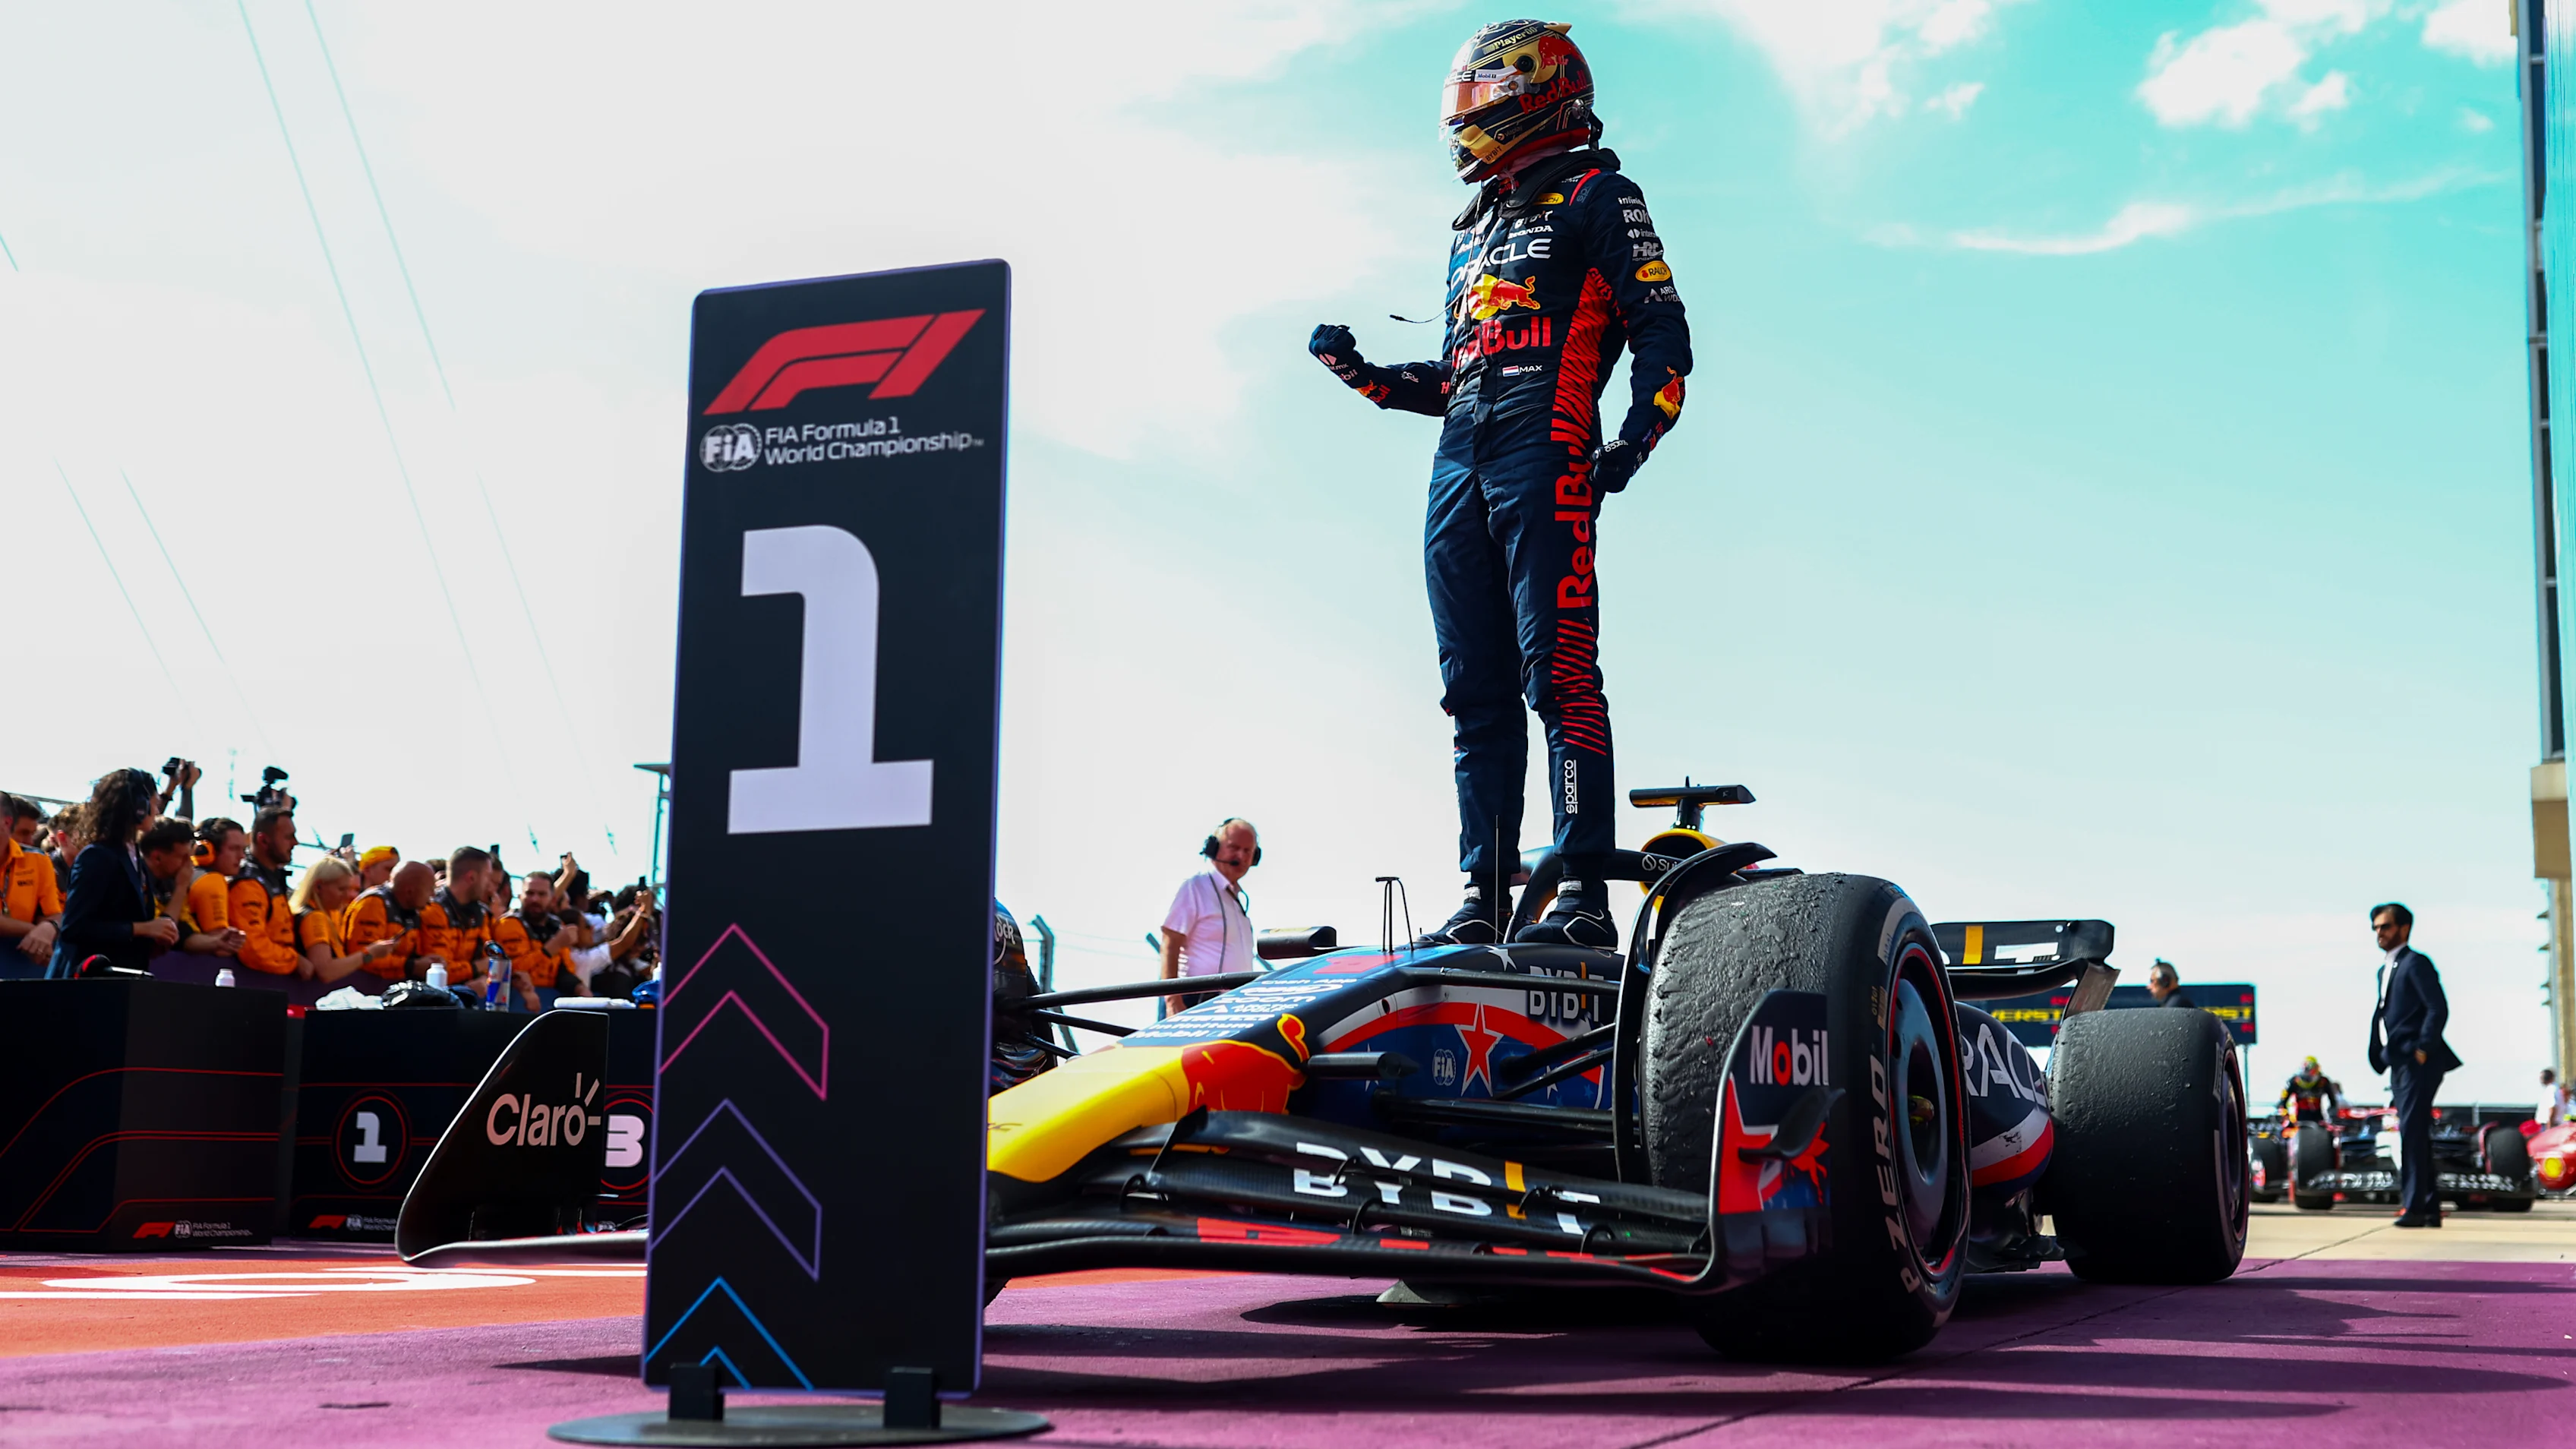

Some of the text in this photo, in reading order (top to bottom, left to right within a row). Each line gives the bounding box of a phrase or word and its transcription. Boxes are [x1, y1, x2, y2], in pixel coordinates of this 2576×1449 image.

[1507, 225, 1555, 240] HONDA
[1648, 266, 1668, 277] RAUCH
[1519, 365, 1543, 374] MAX
[765, 416, 901, 445] FIA Formula 1
[765, 431, 973, 466] World Championship
[728, 524, 934, 834] 1
[1564, 759, 1578, 815] sparco
[1750, 1024, 1829, 1087] Mobil
[353, 1111, 388, 1163] 1
[486, 1093, 586, 1147] Claro
